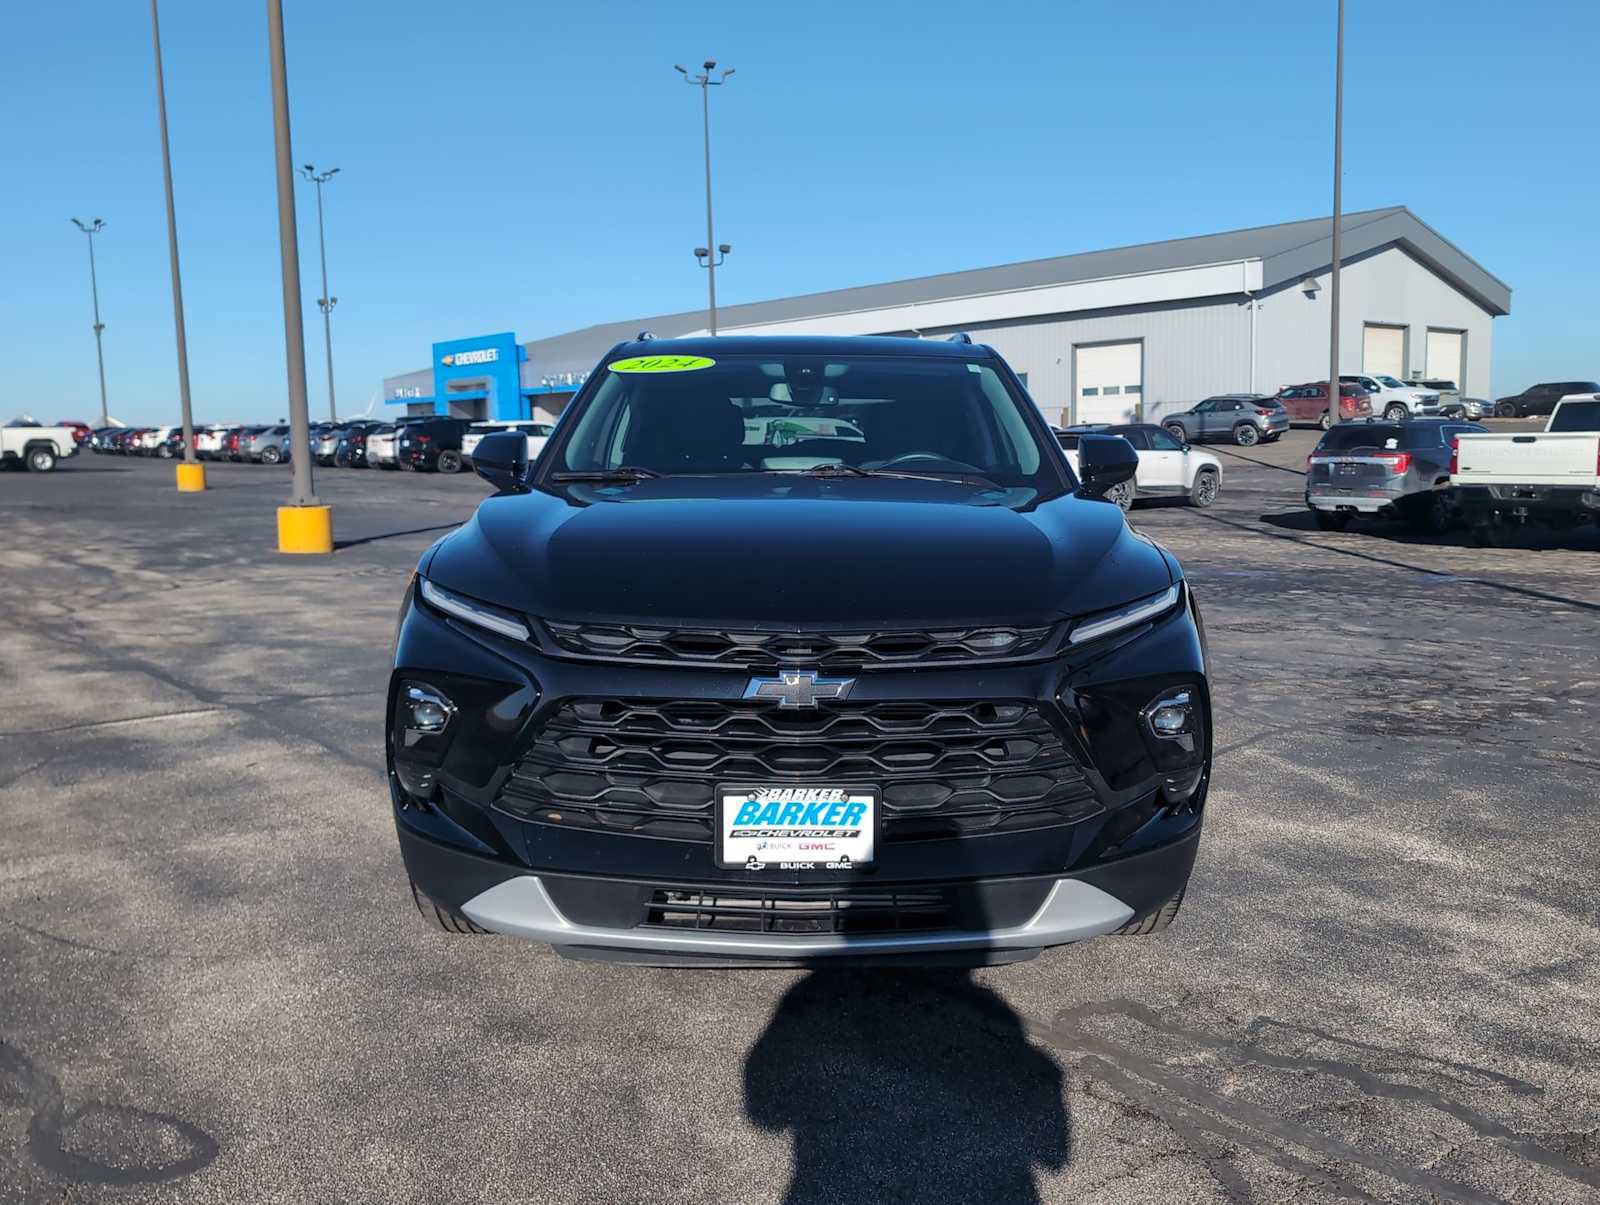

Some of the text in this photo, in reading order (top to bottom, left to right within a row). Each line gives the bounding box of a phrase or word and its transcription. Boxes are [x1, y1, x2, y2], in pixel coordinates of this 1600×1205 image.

[624, 358, 700, 369] 2024
[767, 788, 845, 801] BARKER
[733, 802, 868, 826] BARKER
[756, 830, 856, 838] CHEVROLET
